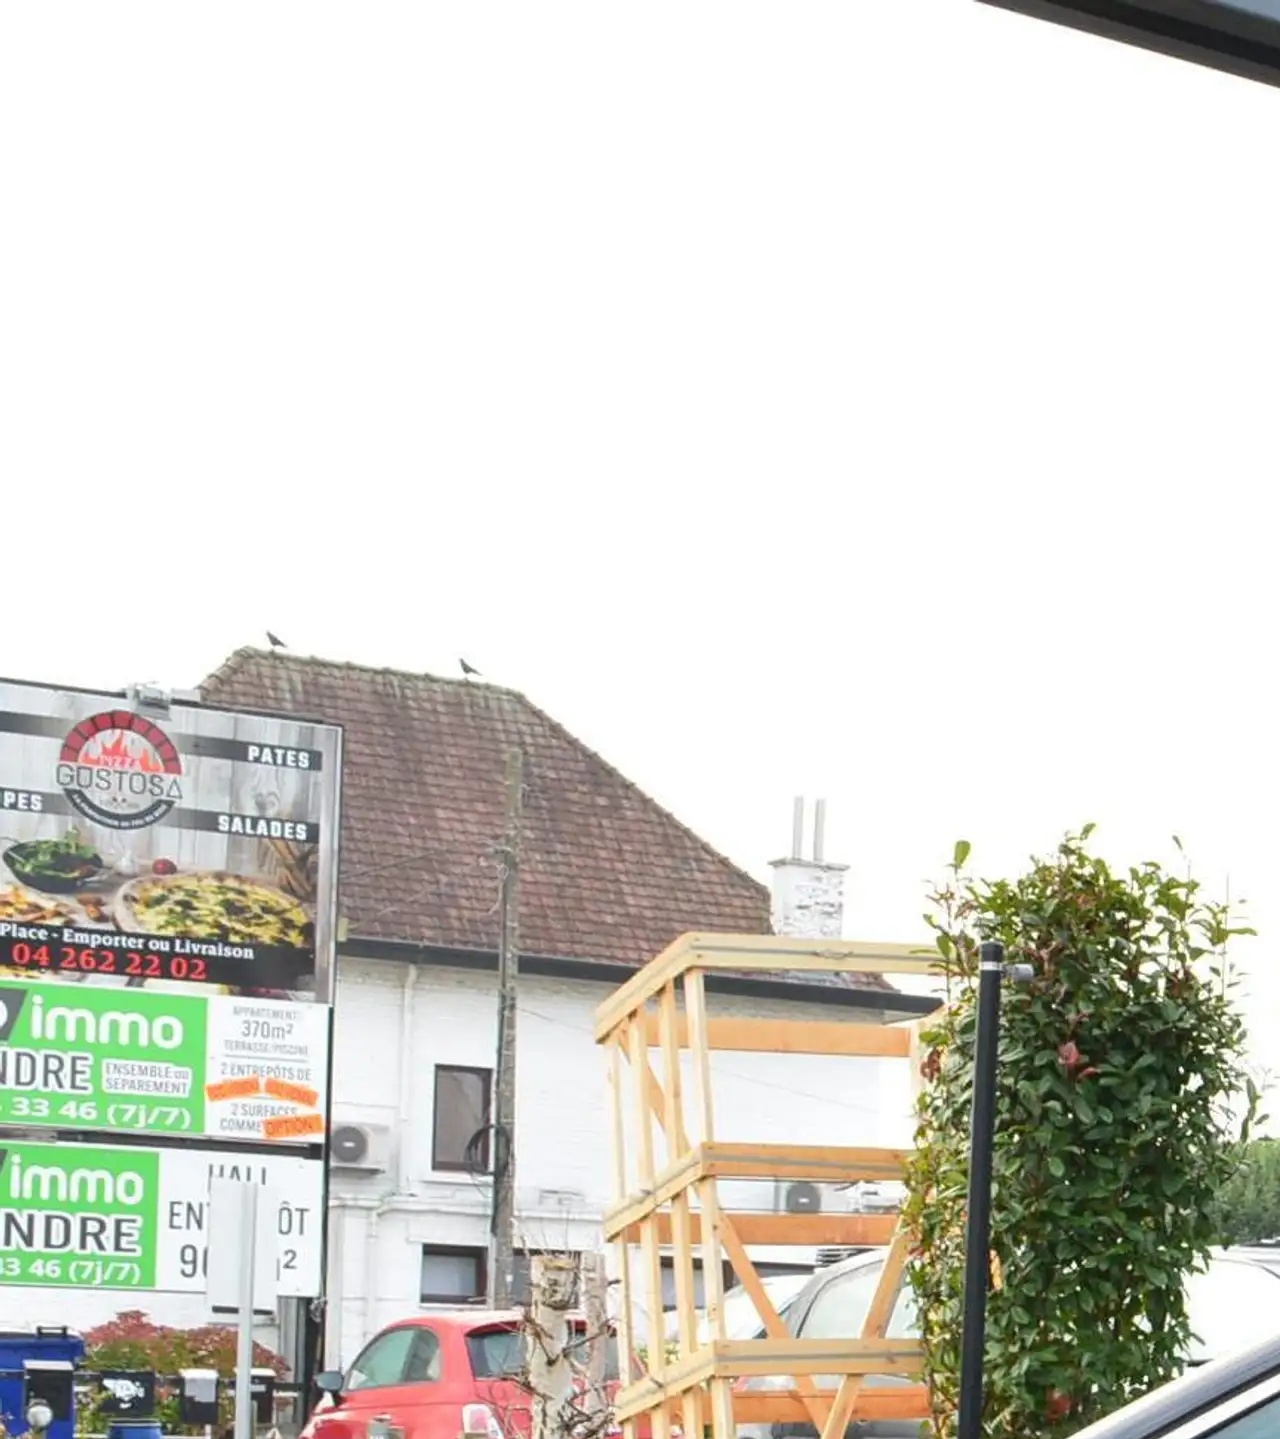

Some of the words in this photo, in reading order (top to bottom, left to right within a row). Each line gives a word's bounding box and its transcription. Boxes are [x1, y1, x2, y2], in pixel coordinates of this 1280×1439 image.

[248, 746, 310, 768] PATES
[56, 763, 183, 799] GUSTOSA
[3, 790, 43, 811] PES
[218, 815, 307, 840] SALADES
[0, 923, 47, 941] Place
[63, 929, 143, 950] Emporter
[149, 940, 170, 951] ou
[175, 940, 254, 960] Livraison
[12, 944, 49, 966] 04
[60, 947, 116, 972] 262
[125, 954, 162, 976] 22
[171, 957, 207, 979] 02
[31, 995, 183, 1049] immo
[0, 1051, 91, 1092] DRE
[105, 1062, 171, 1079] ENSEMBLE
[297, 1068, 312, 1081] DE
[10, 1096, 50, 1117] 33
[58, 1099, 97, 1120] 46
[107, 1104, 191, 1130] (7j/7)
[9, 1154, 144, 1205] immo
[3, 1211, 138, 1253] NDRE
[29, 1258, 61, 1278] 46
